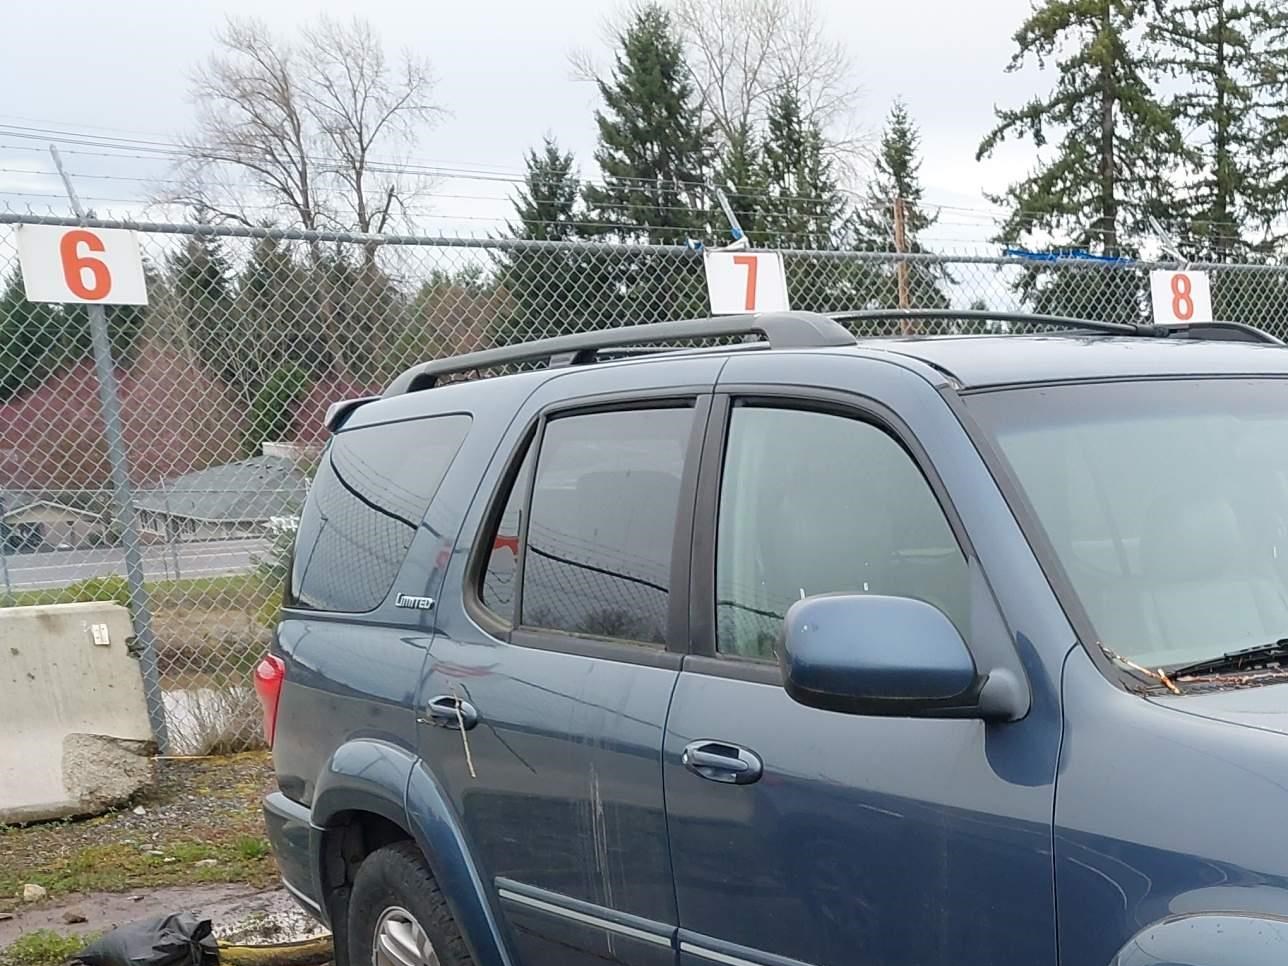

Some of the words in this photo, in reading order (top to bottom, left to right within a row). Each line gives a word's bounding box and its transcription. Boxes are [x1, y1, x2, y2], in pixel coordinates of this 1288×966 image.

[60, 229, 113, 301] 6
[733, 255, 758, 311] 7
[1170, 273, 1195, 321] 8
